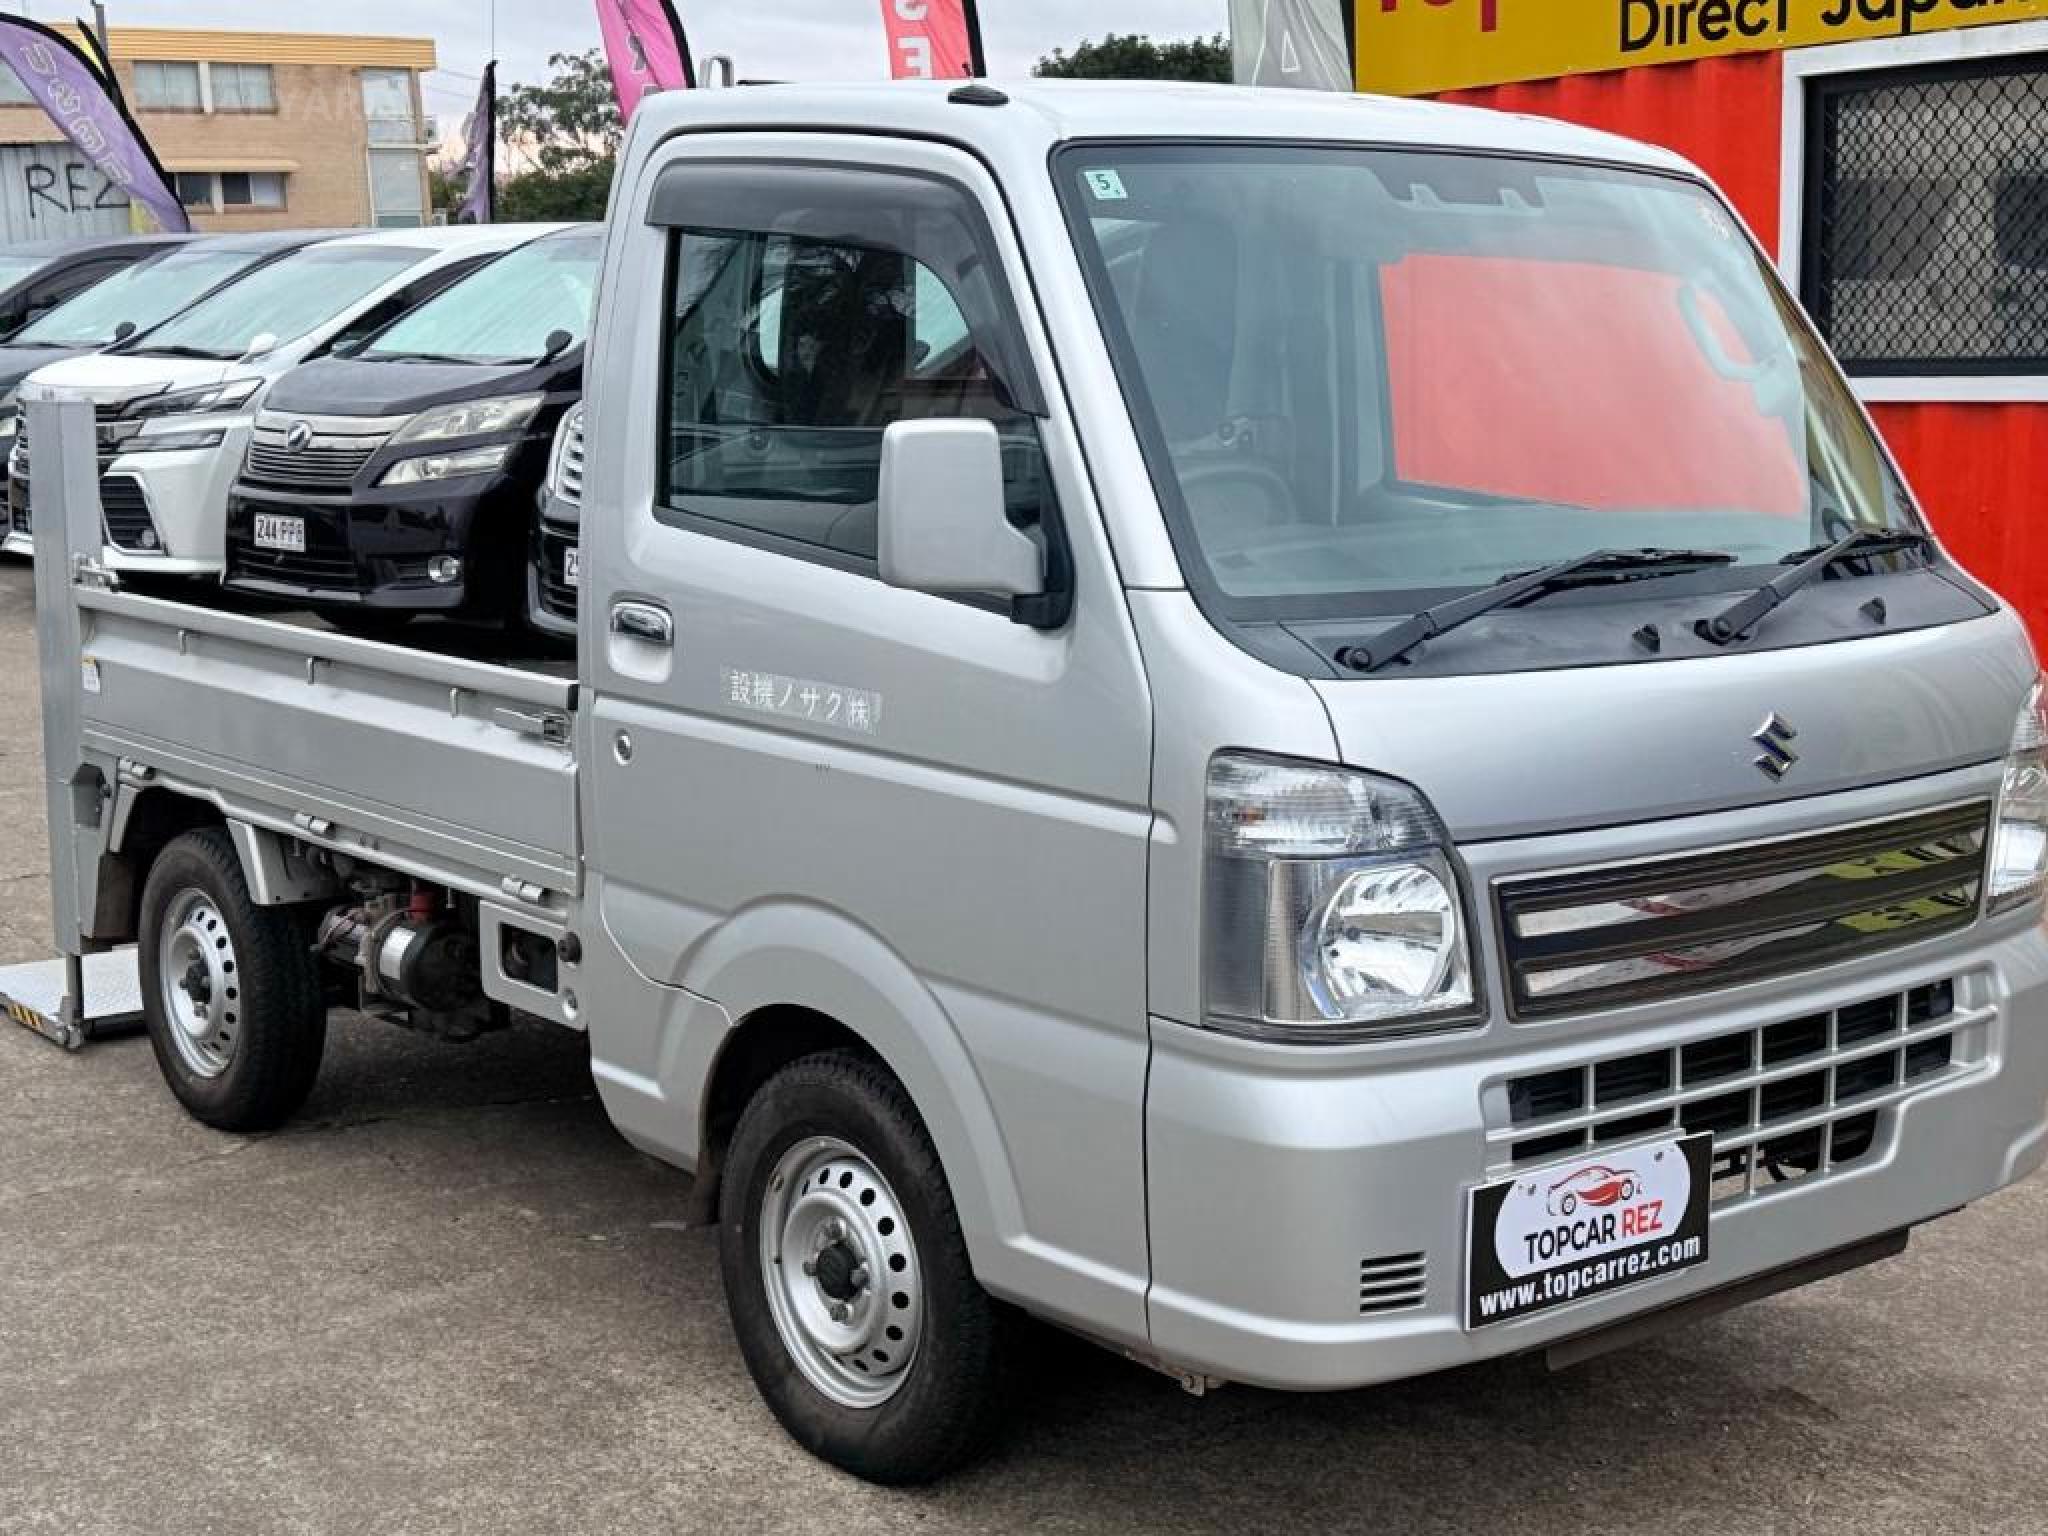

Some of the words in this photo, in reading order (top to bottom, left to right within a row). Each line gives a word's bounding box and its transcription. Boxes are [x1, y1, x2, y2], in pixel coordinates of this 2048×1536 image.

[1523, 1213, 1617, 1264] TOPCAR
[1621, 1199, 1664, 1238] REZ
[1479, 1235, 1700, 1317] www.topcarrez.com
